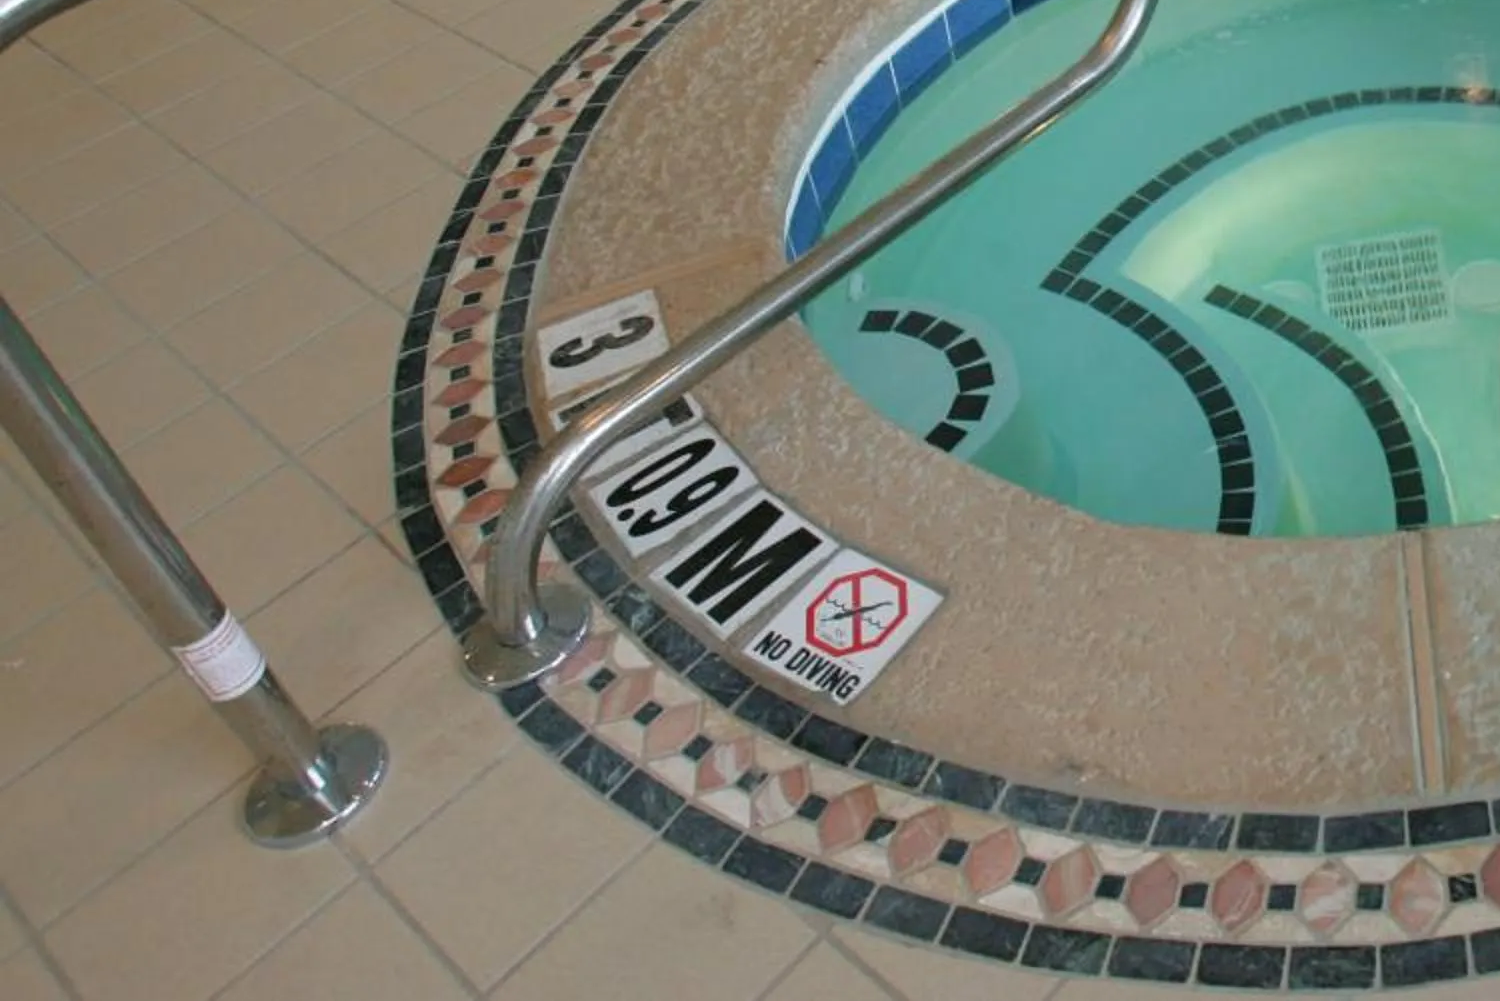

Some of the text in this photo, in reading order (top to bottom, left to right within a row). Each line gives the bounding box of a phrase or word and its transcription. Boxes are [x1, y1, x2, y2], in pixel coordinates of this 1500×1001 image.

[549, 315, 655, 369] 3
[606, 438, 739, 537] 0.9
[665, 499, 823, 626] M
[753, 630, 861, 700] NO DIVING
